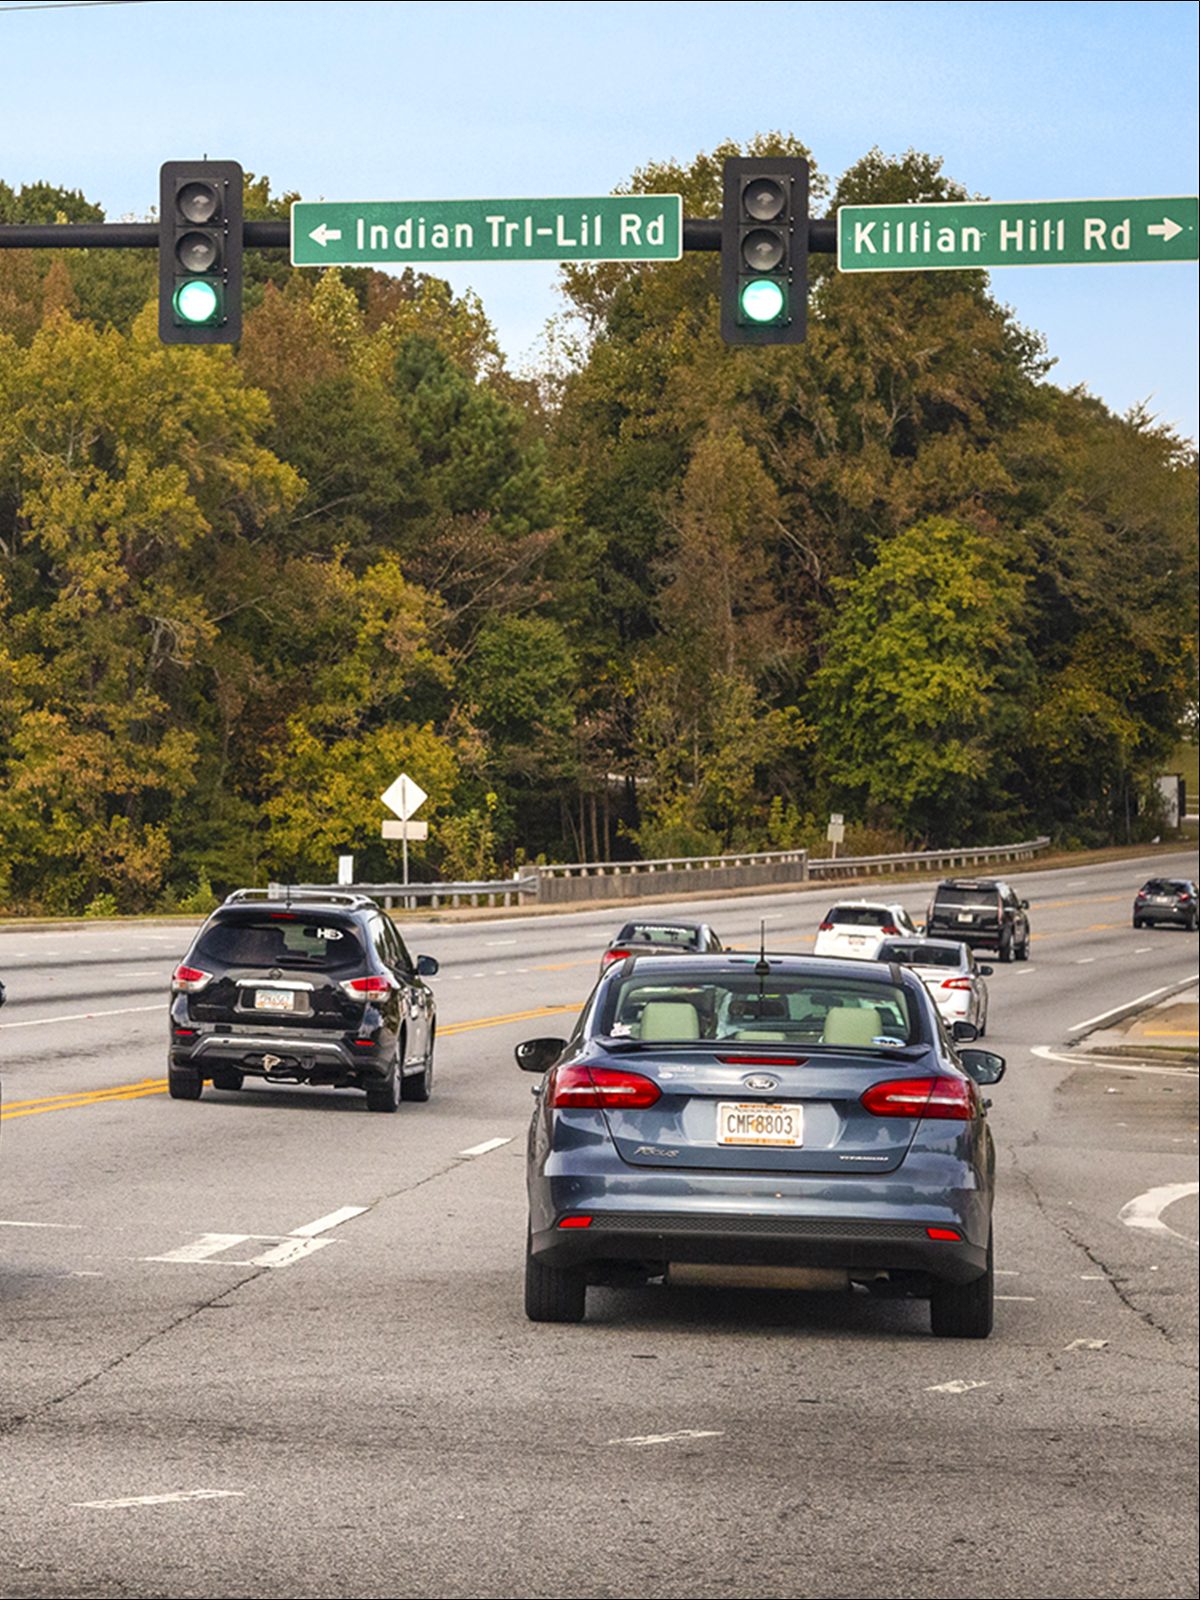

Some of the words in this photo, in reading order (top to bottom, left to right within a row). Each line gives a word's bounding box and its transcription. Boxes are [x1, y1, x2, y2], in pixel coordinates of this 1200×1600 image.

[356, 218, 474, 250] Indian
[620, 213, 664, 246] Rd
[854, 221, 981, 254] Killian
[1000, 219, 1065, 252] Hill
[1084, 218, 1130, 251] Rd
[726, 1113, 794, 1136] CMF8803
